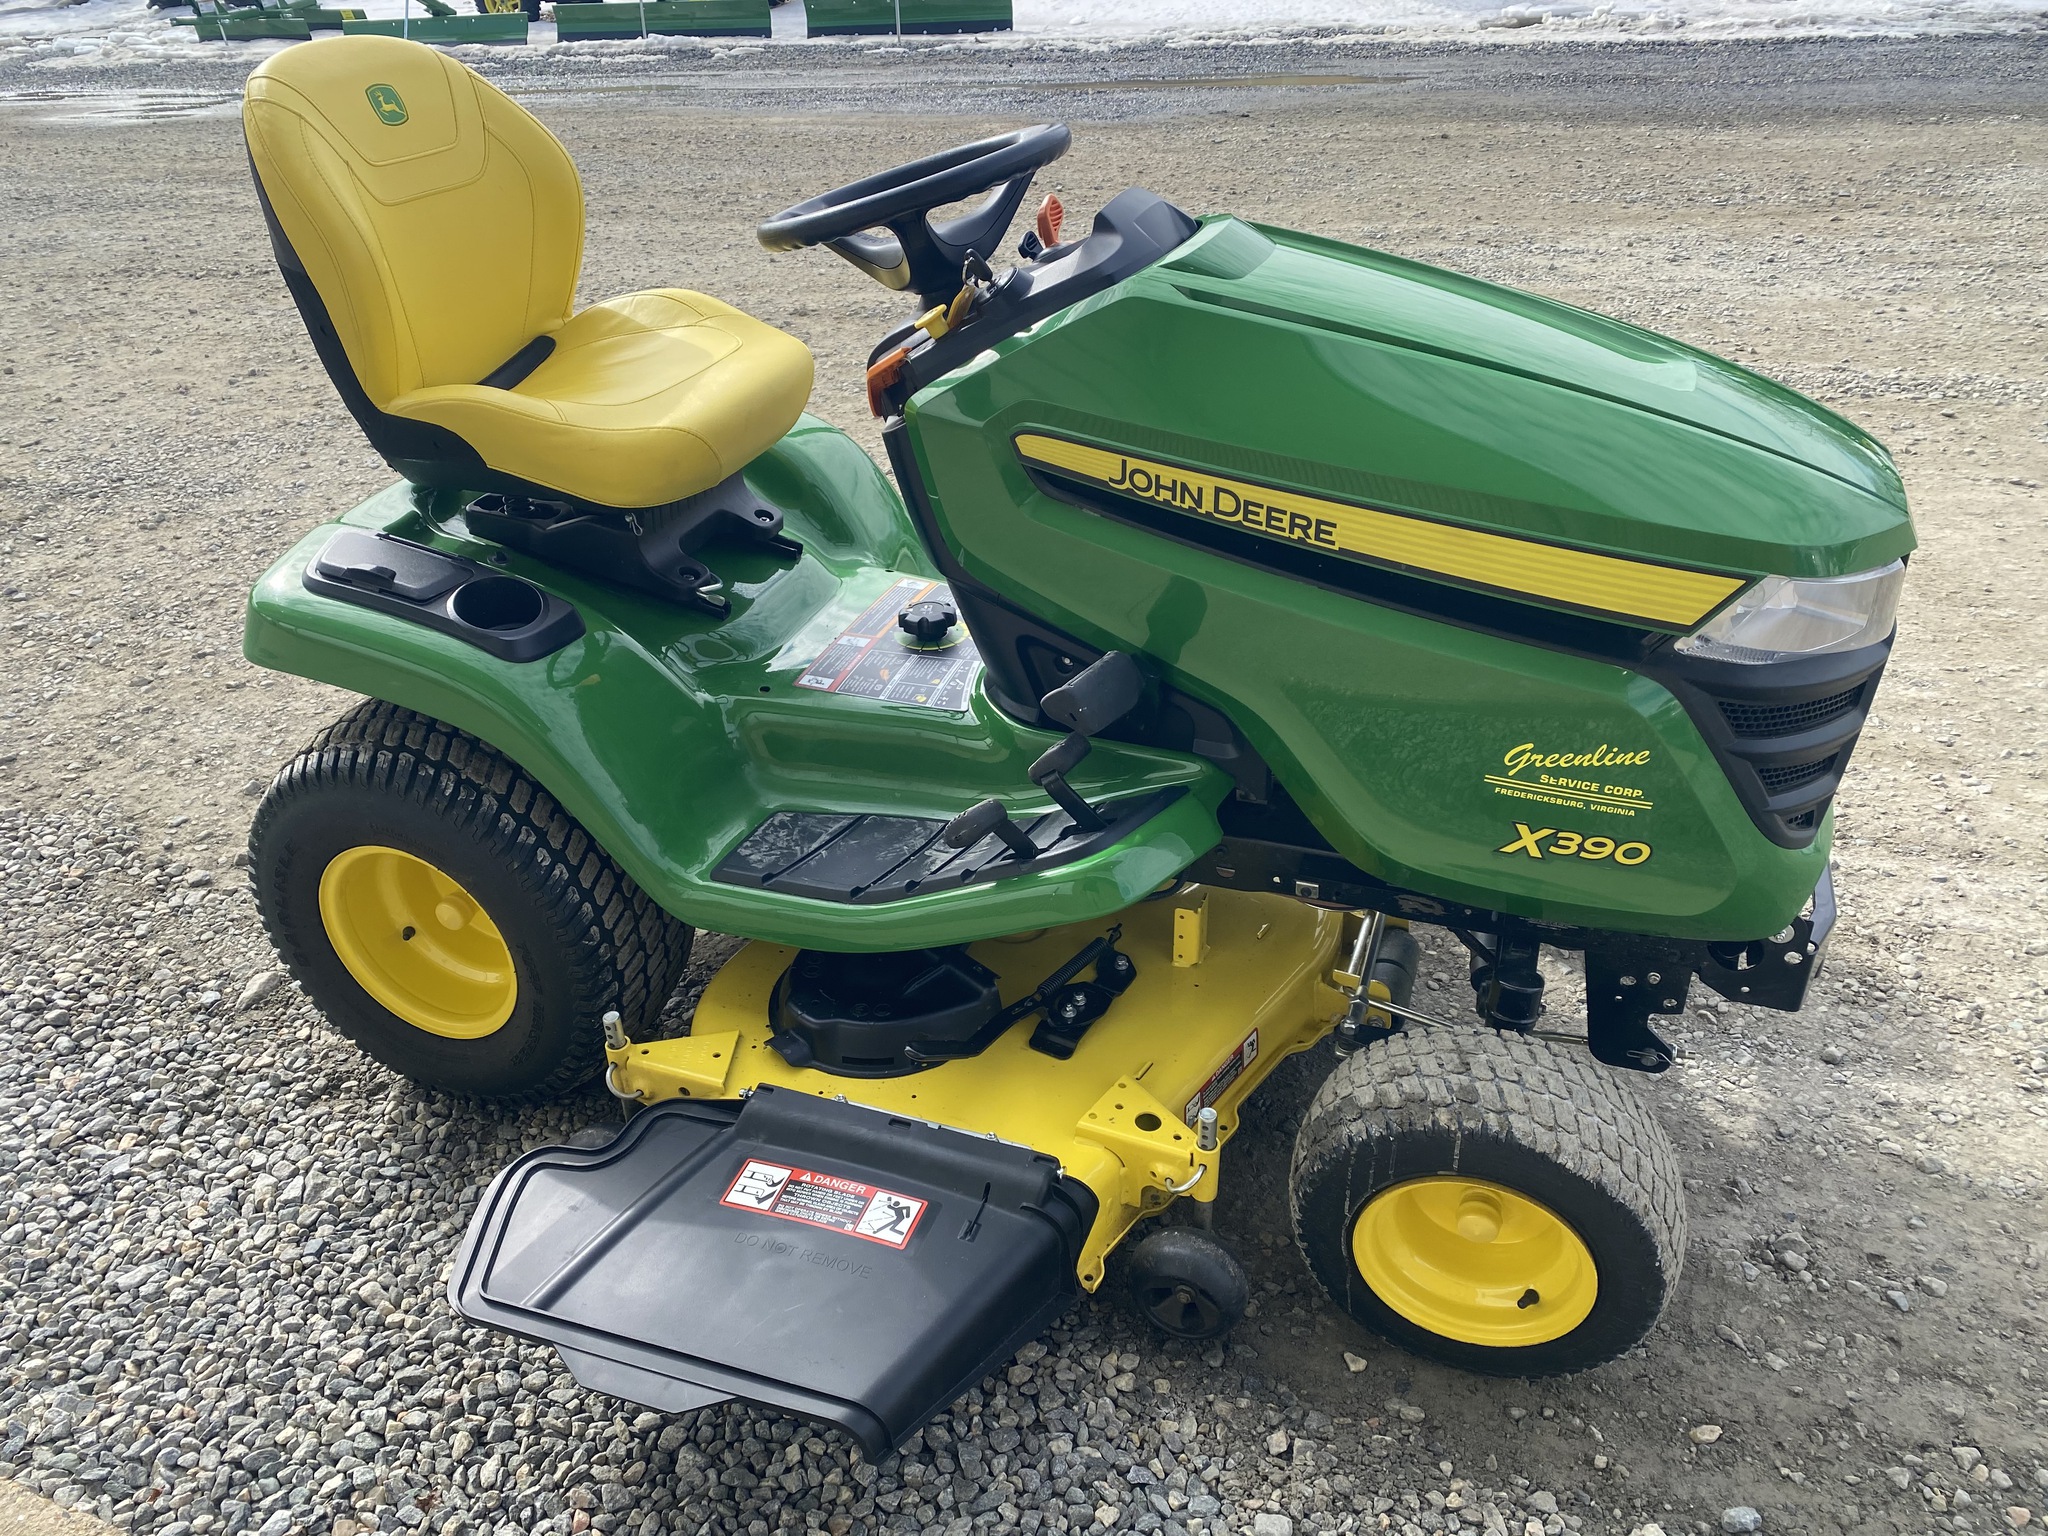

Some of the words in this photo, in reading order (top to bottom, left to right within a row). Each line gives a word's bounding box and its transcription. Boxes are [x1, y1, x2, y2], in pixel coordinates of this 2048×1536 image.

[1108, 459, 1203, 511] JOHN
[1214, 486, 1338, 547] DEERE
[1504, 743, 1650, 776] Greenline
[1540, 774, 1600, 792] SERVICE
[1603, 785, 1645, 799] CORP.
[1495, 787, 1587, 810] FREDERICKSBURG,
[1590, 804, 1635, 817] VIRGINIA
[1497, 822, 1652, 866] X390
[801, 1182, 833, 1193] ROTATING
[834, 1190, 855, 1198] BLADE
[813, 1175, 866, 1194] DANGER
[793, 1192, 821, 1202] THROWN
[821, 1199, 851, 1209] OBJECTS
[734, 1232, 759, 1247] DO
[762, 1237, 798, 1255] NOT
[799, 1249, 873, 1279] REMOVE
